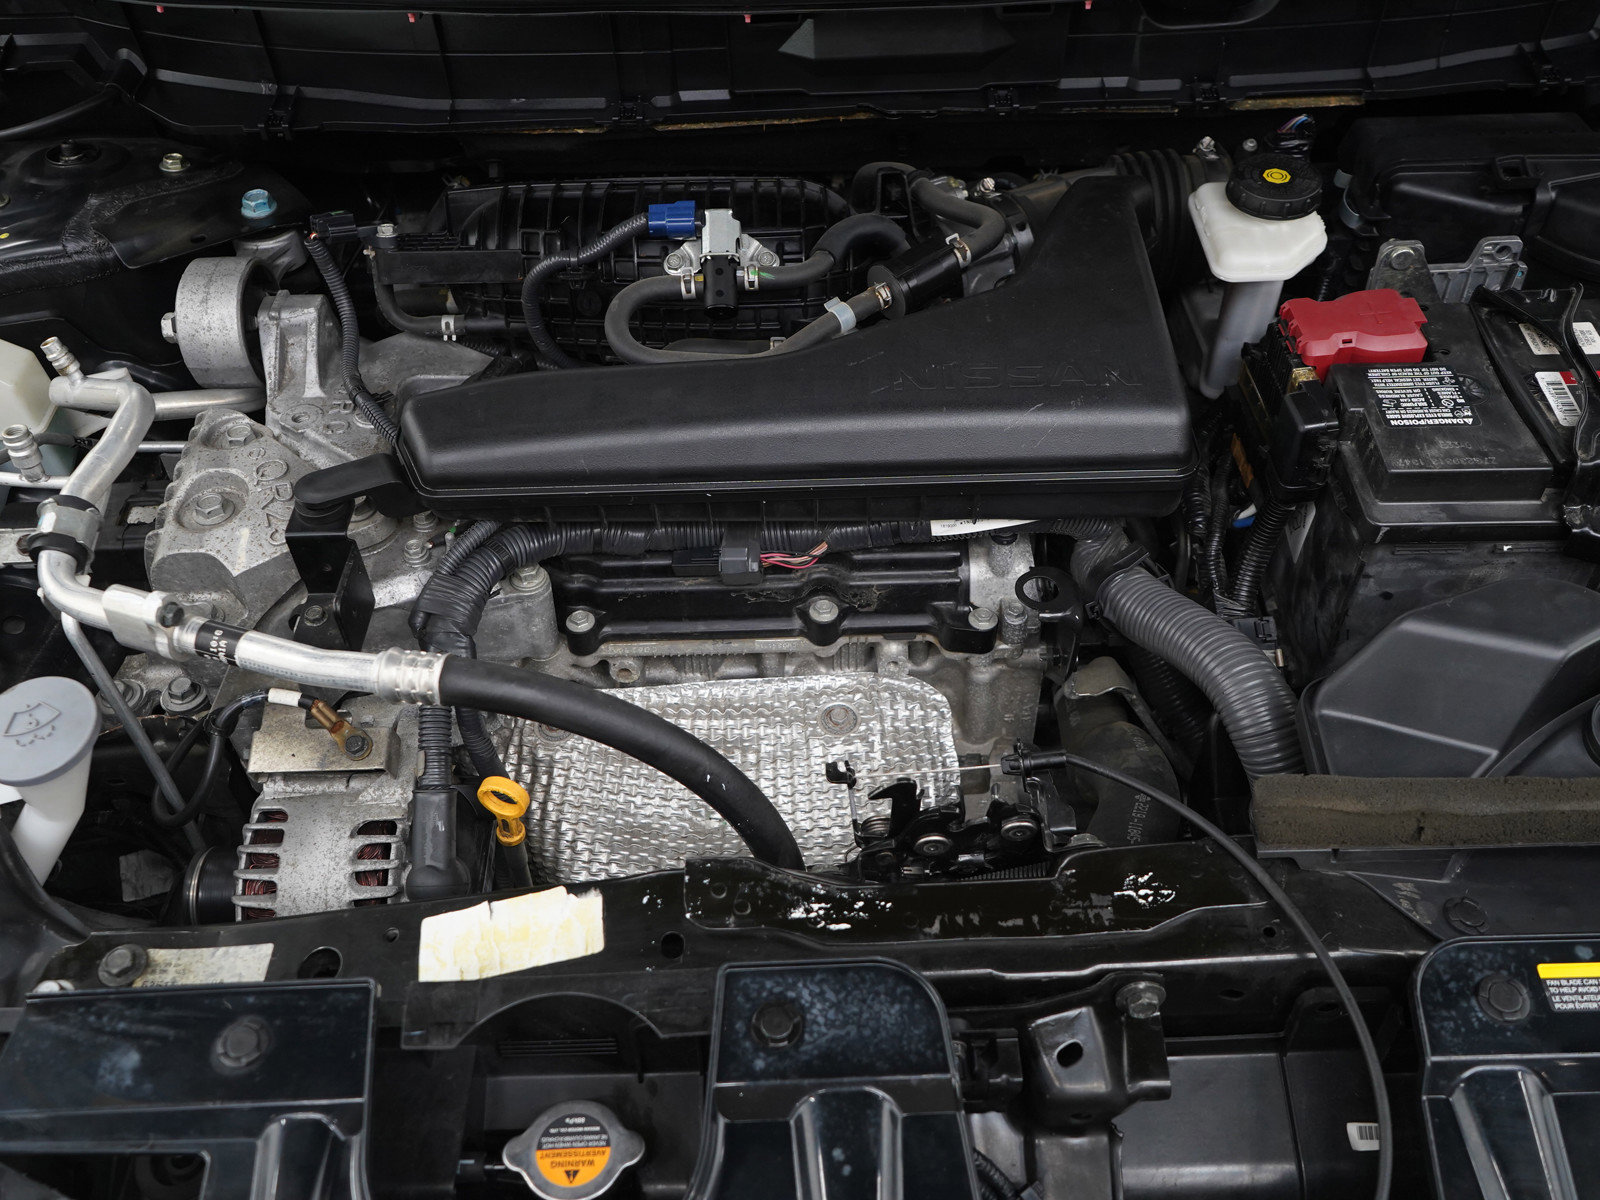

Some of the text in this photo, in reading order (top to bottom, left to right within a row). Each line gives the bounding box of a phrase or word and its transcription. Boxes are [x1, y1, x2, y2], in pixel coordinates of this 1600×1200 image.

[1390, 418, 1464, 426] DANGER/POISON
[540, 1150, 606, 1160] AVERTISSEMENT
[550, 1160, 594, 1168] WARNING
